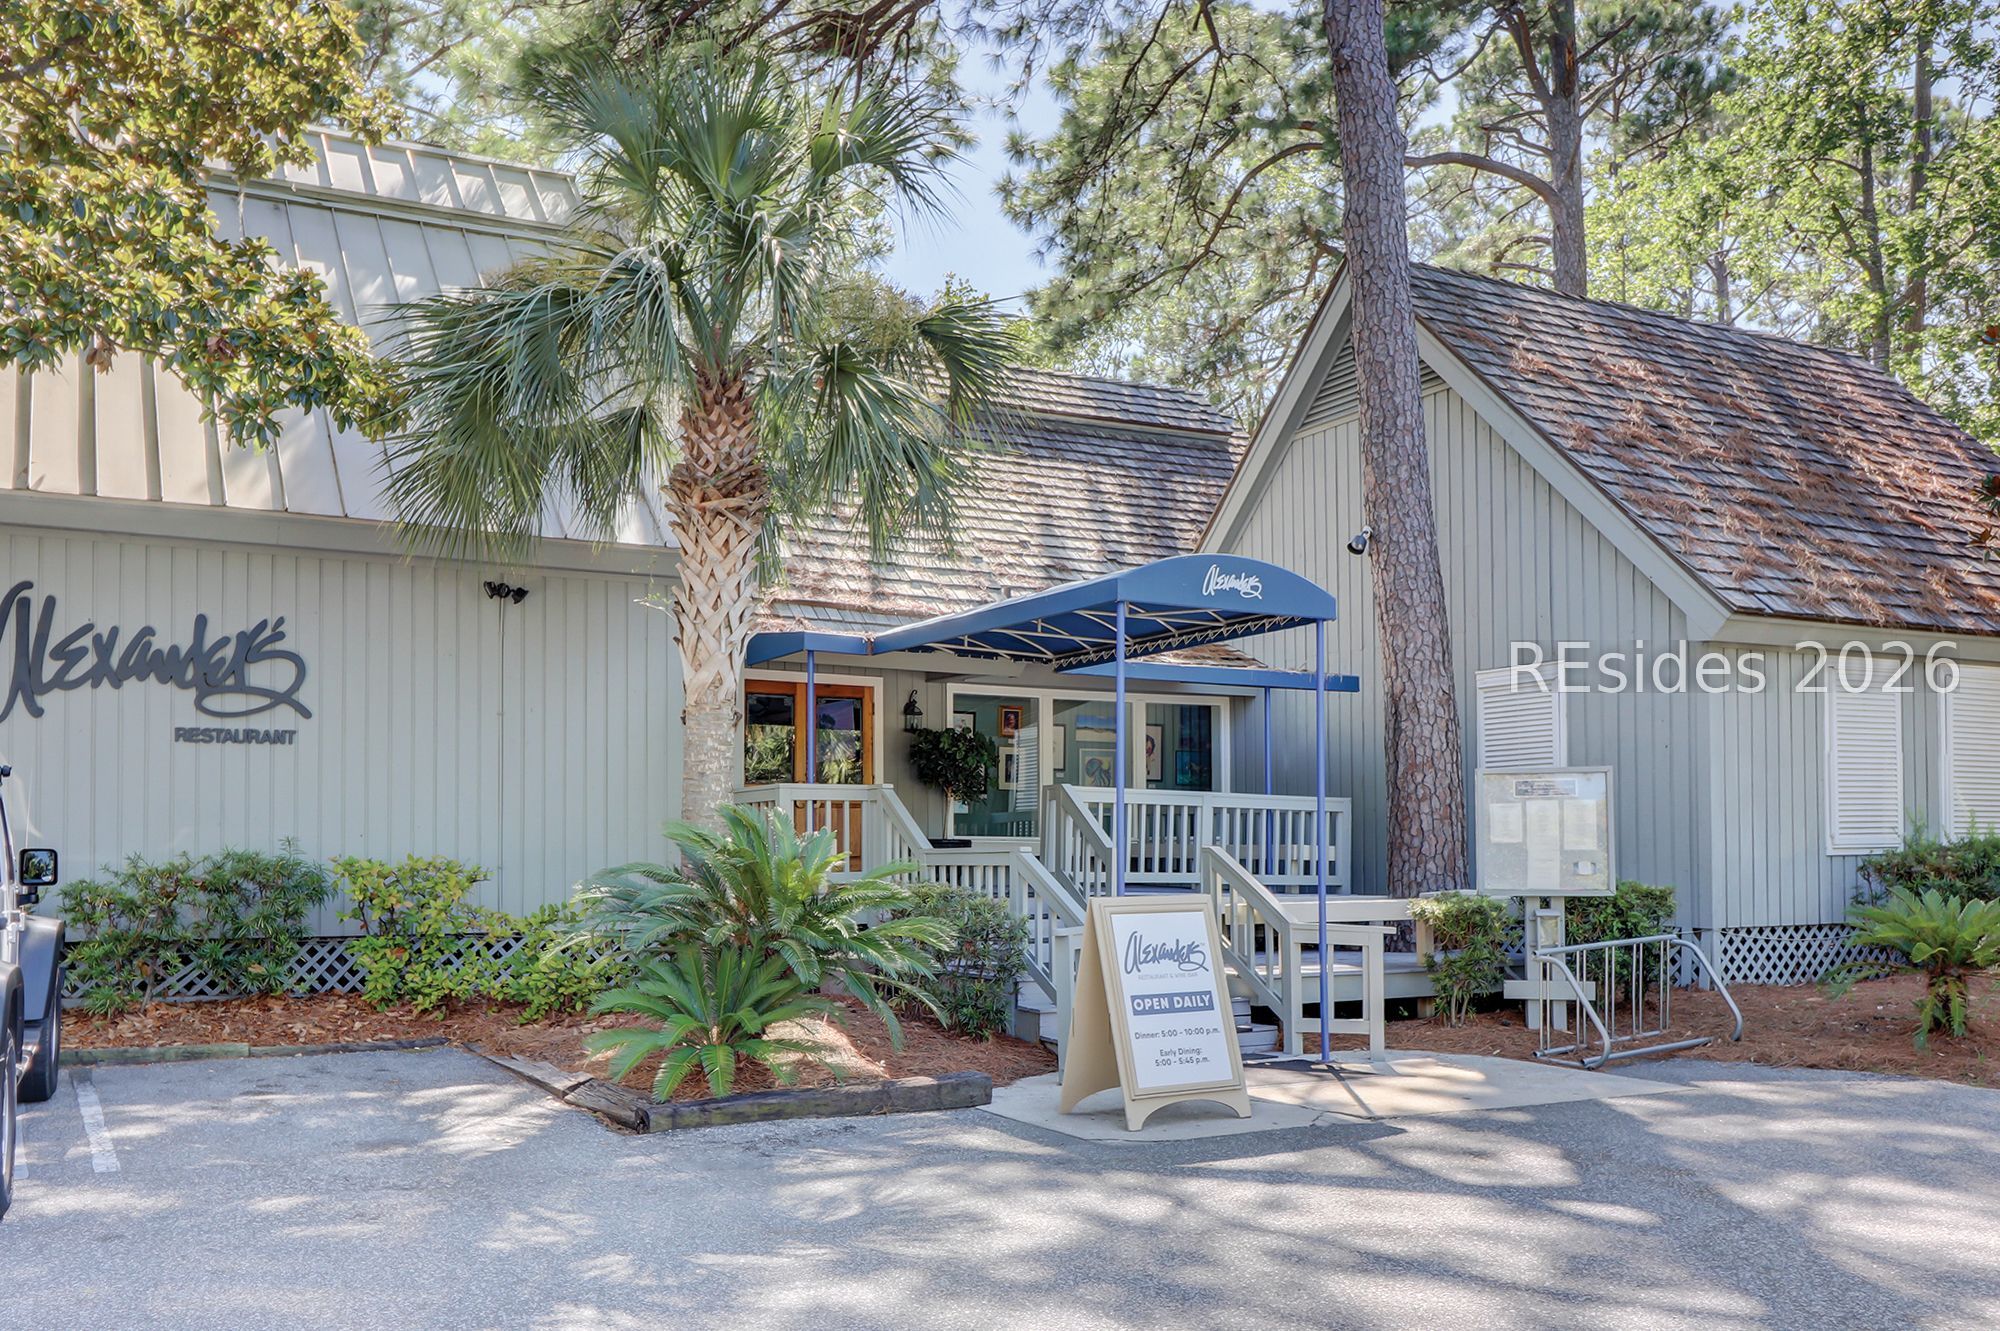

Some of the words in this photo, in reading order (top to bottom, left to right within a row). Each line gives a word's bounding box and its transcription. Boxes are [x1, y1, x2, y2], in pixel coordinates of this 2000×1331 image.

[174, 727, 297, 745] RESTAURANT
[1133, 997, 1169, 1011] OPEN
[1172, 994, 1210, 1009] DAILY
[1134, 1031, 1160, 1040] Dinner:
[1161, 1029, 1178, 1038] 5:00
[1184, 1027, 1205, 1036] 10:00
[1159, 1048, 1177, 1058] Early
[1154, 1058, 1172, 1067] 5:00
[1178, 1056, 1195, 1065] 5:45
